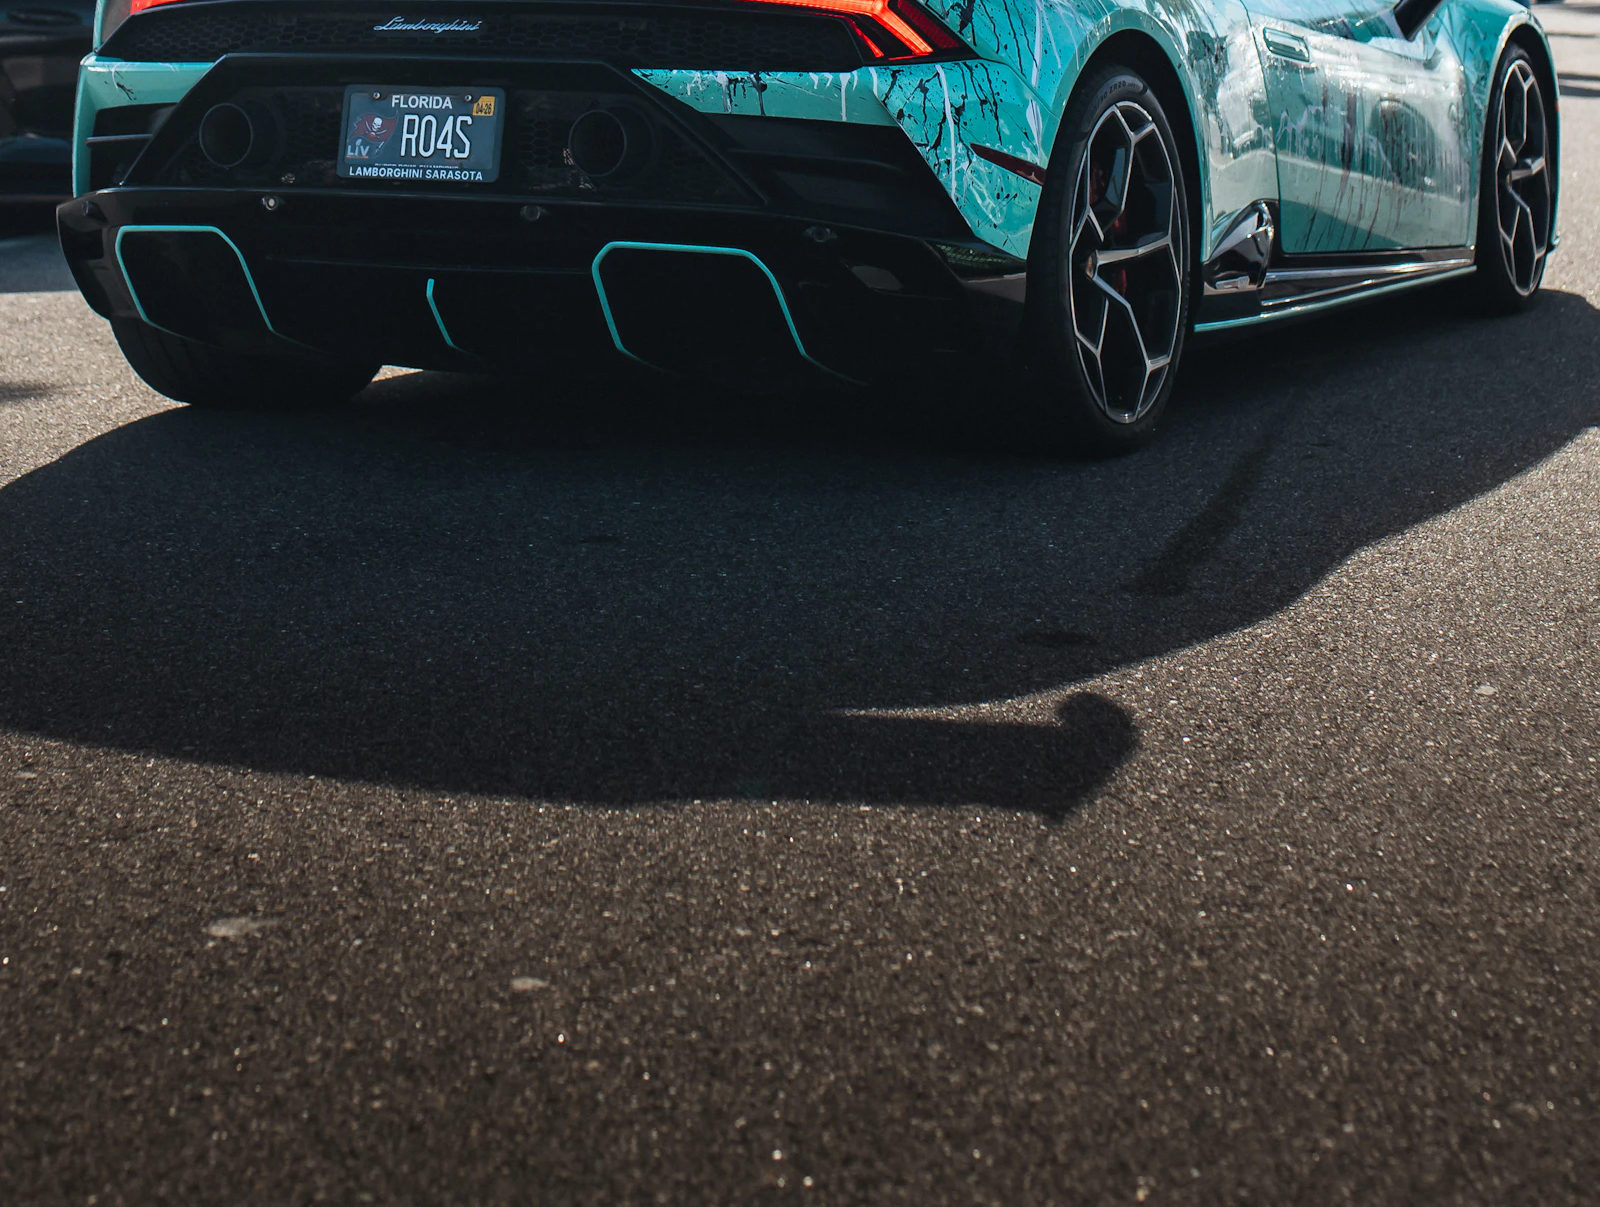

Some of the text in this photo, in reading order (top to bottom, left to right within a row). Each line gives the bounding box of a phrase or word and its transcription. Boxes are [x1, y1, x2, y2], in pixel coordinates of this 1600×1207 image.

[373, 16, 483, 34] Lamborghini
[391, 95, 453, 110] FLORIDA
[475, 103, 493, 115] 04-26
[349, 166, 483, 181] LAMBORGHINI SARASOTA
